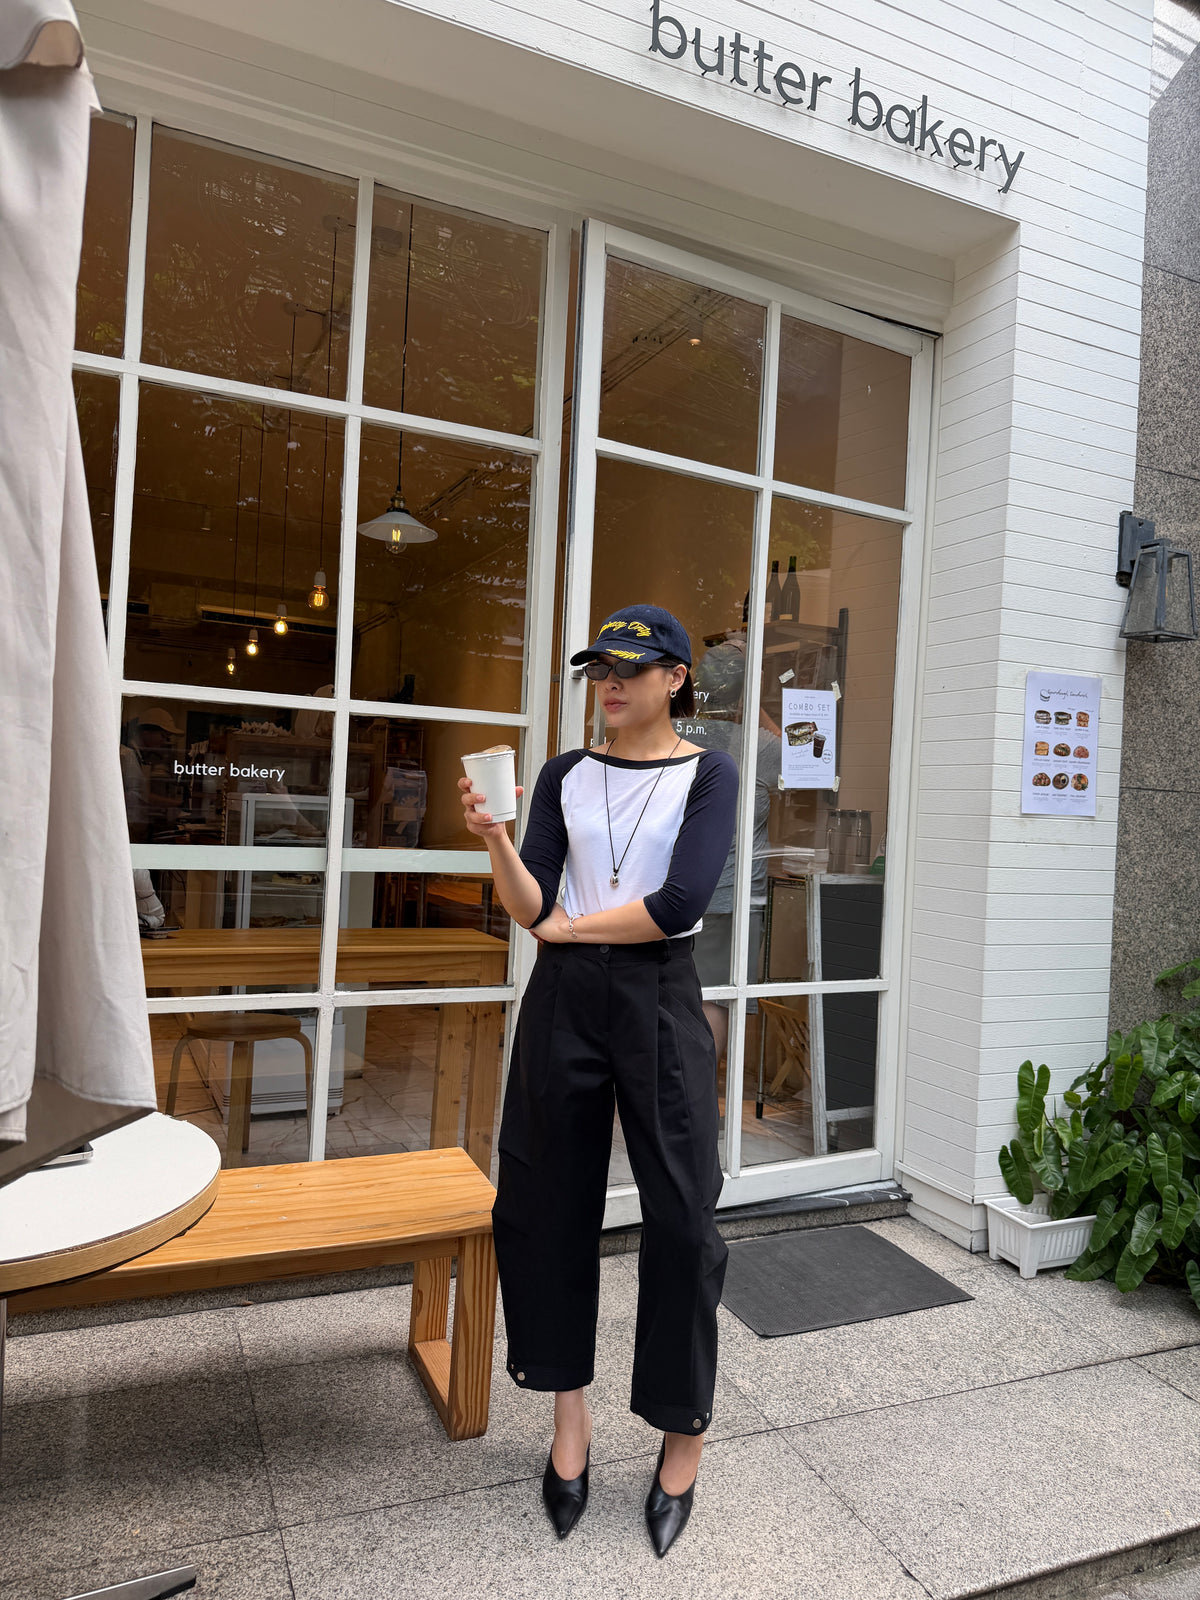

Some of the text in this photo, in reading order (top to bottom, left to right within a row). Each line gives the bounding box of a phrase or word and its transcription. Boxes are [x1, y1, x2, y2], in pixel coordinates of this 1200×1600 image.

[651, 0, 1026, 193] butter bakery
[788, 702, 831, 712] COMBO SET
[686, 725, 707, 736] p.m.
[173, 760, 286, 782] butter bakery
